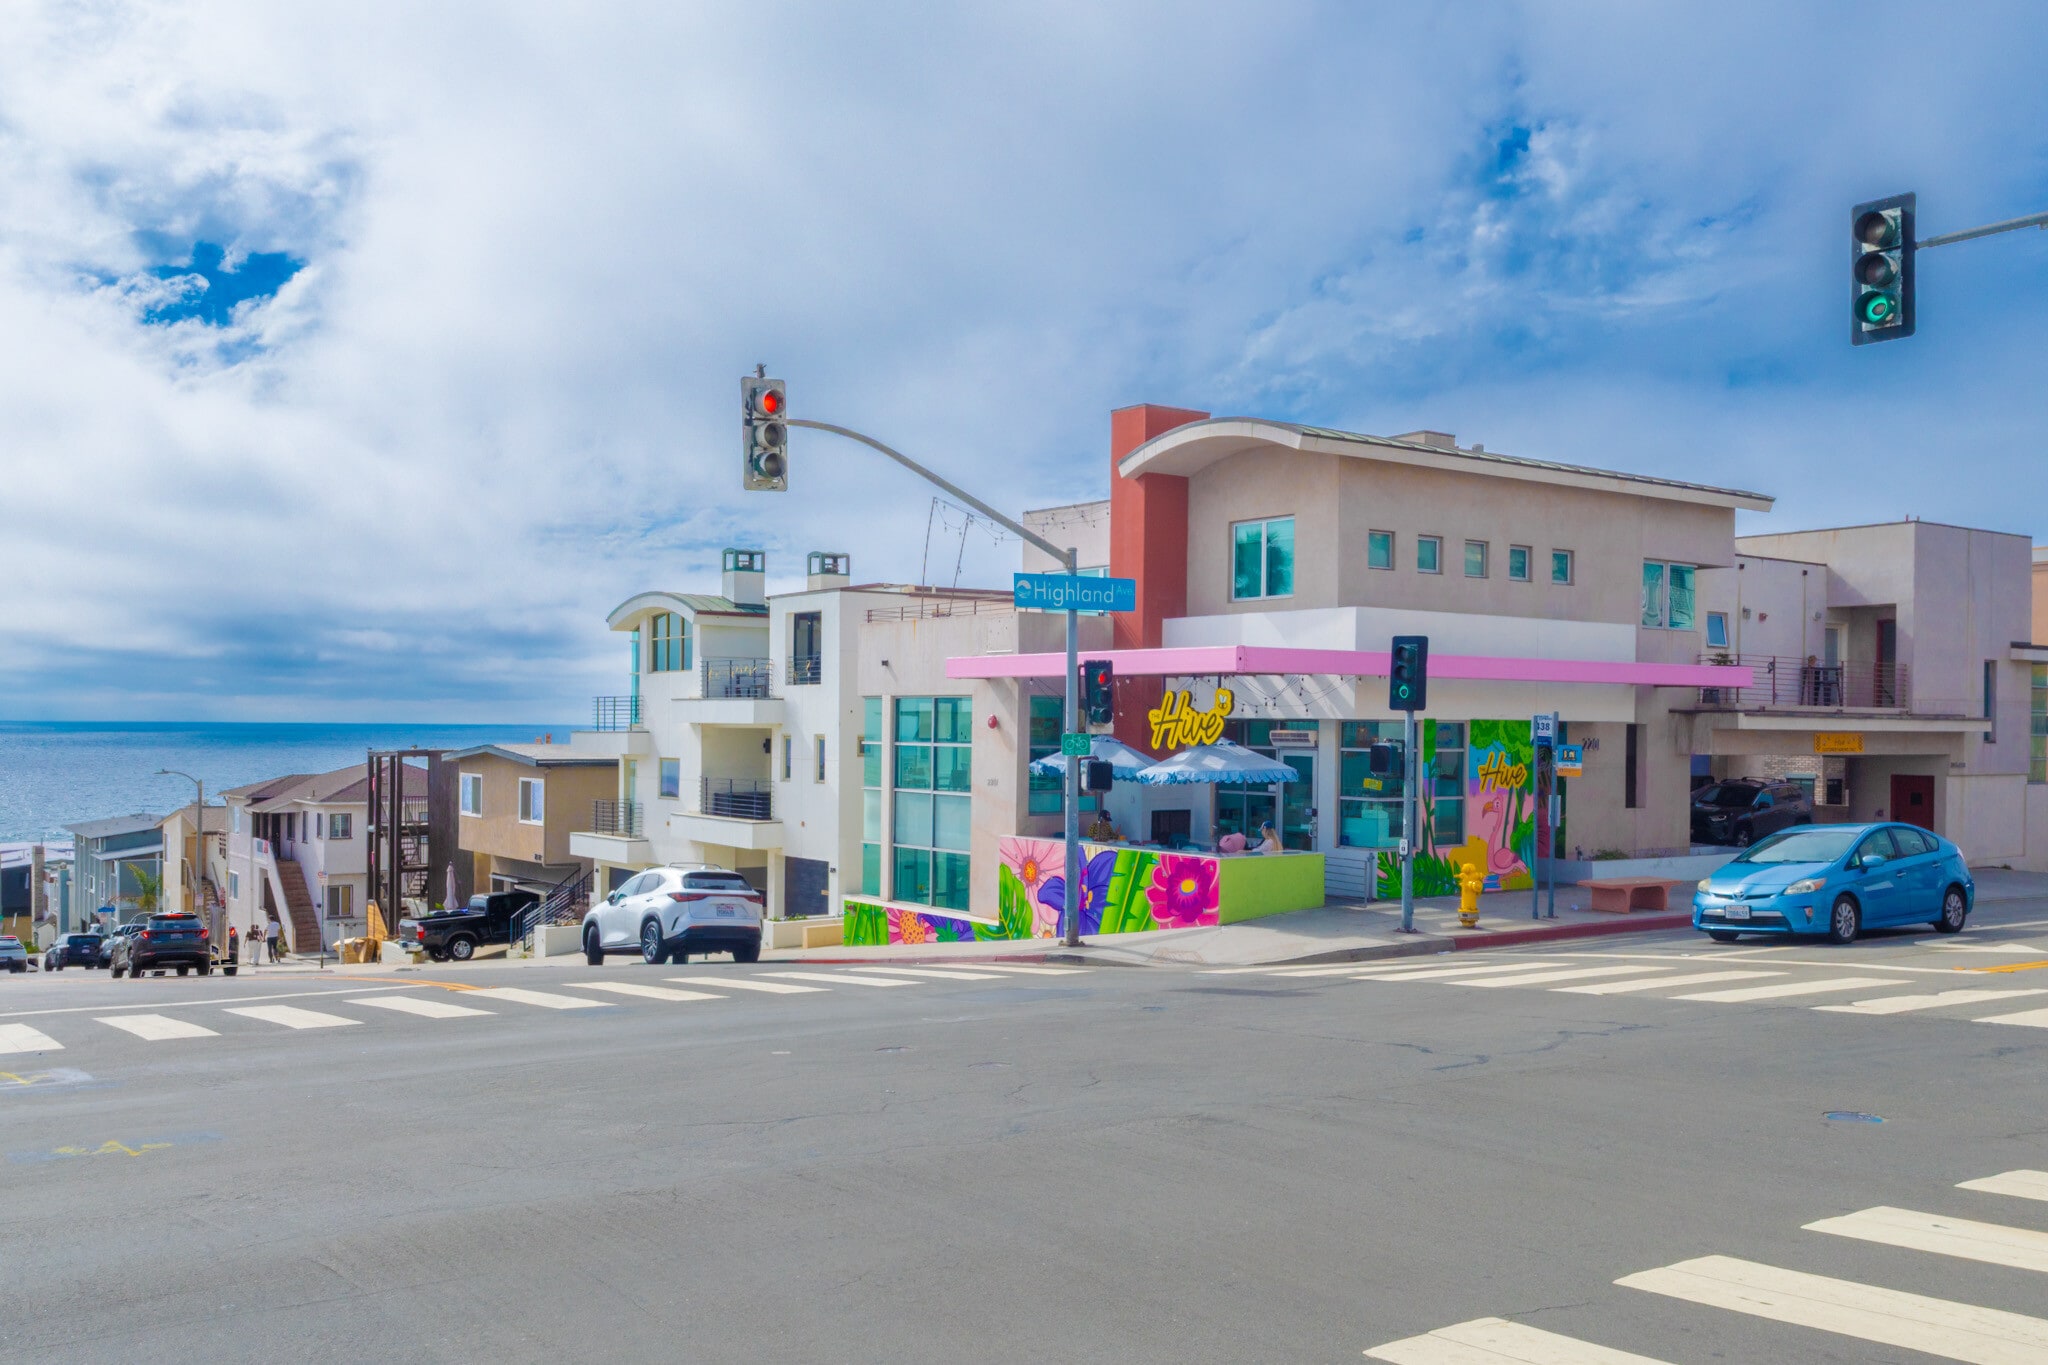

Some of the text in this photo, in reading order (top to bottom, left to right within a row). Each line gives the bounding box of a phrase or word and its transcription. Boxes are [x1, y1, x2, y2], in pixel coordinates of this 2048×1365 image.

[1034, 580, 1114, 607] Highland
[1153, 693, 1222, 747] Hive
[1480, 752, 1526, 790] Hive
